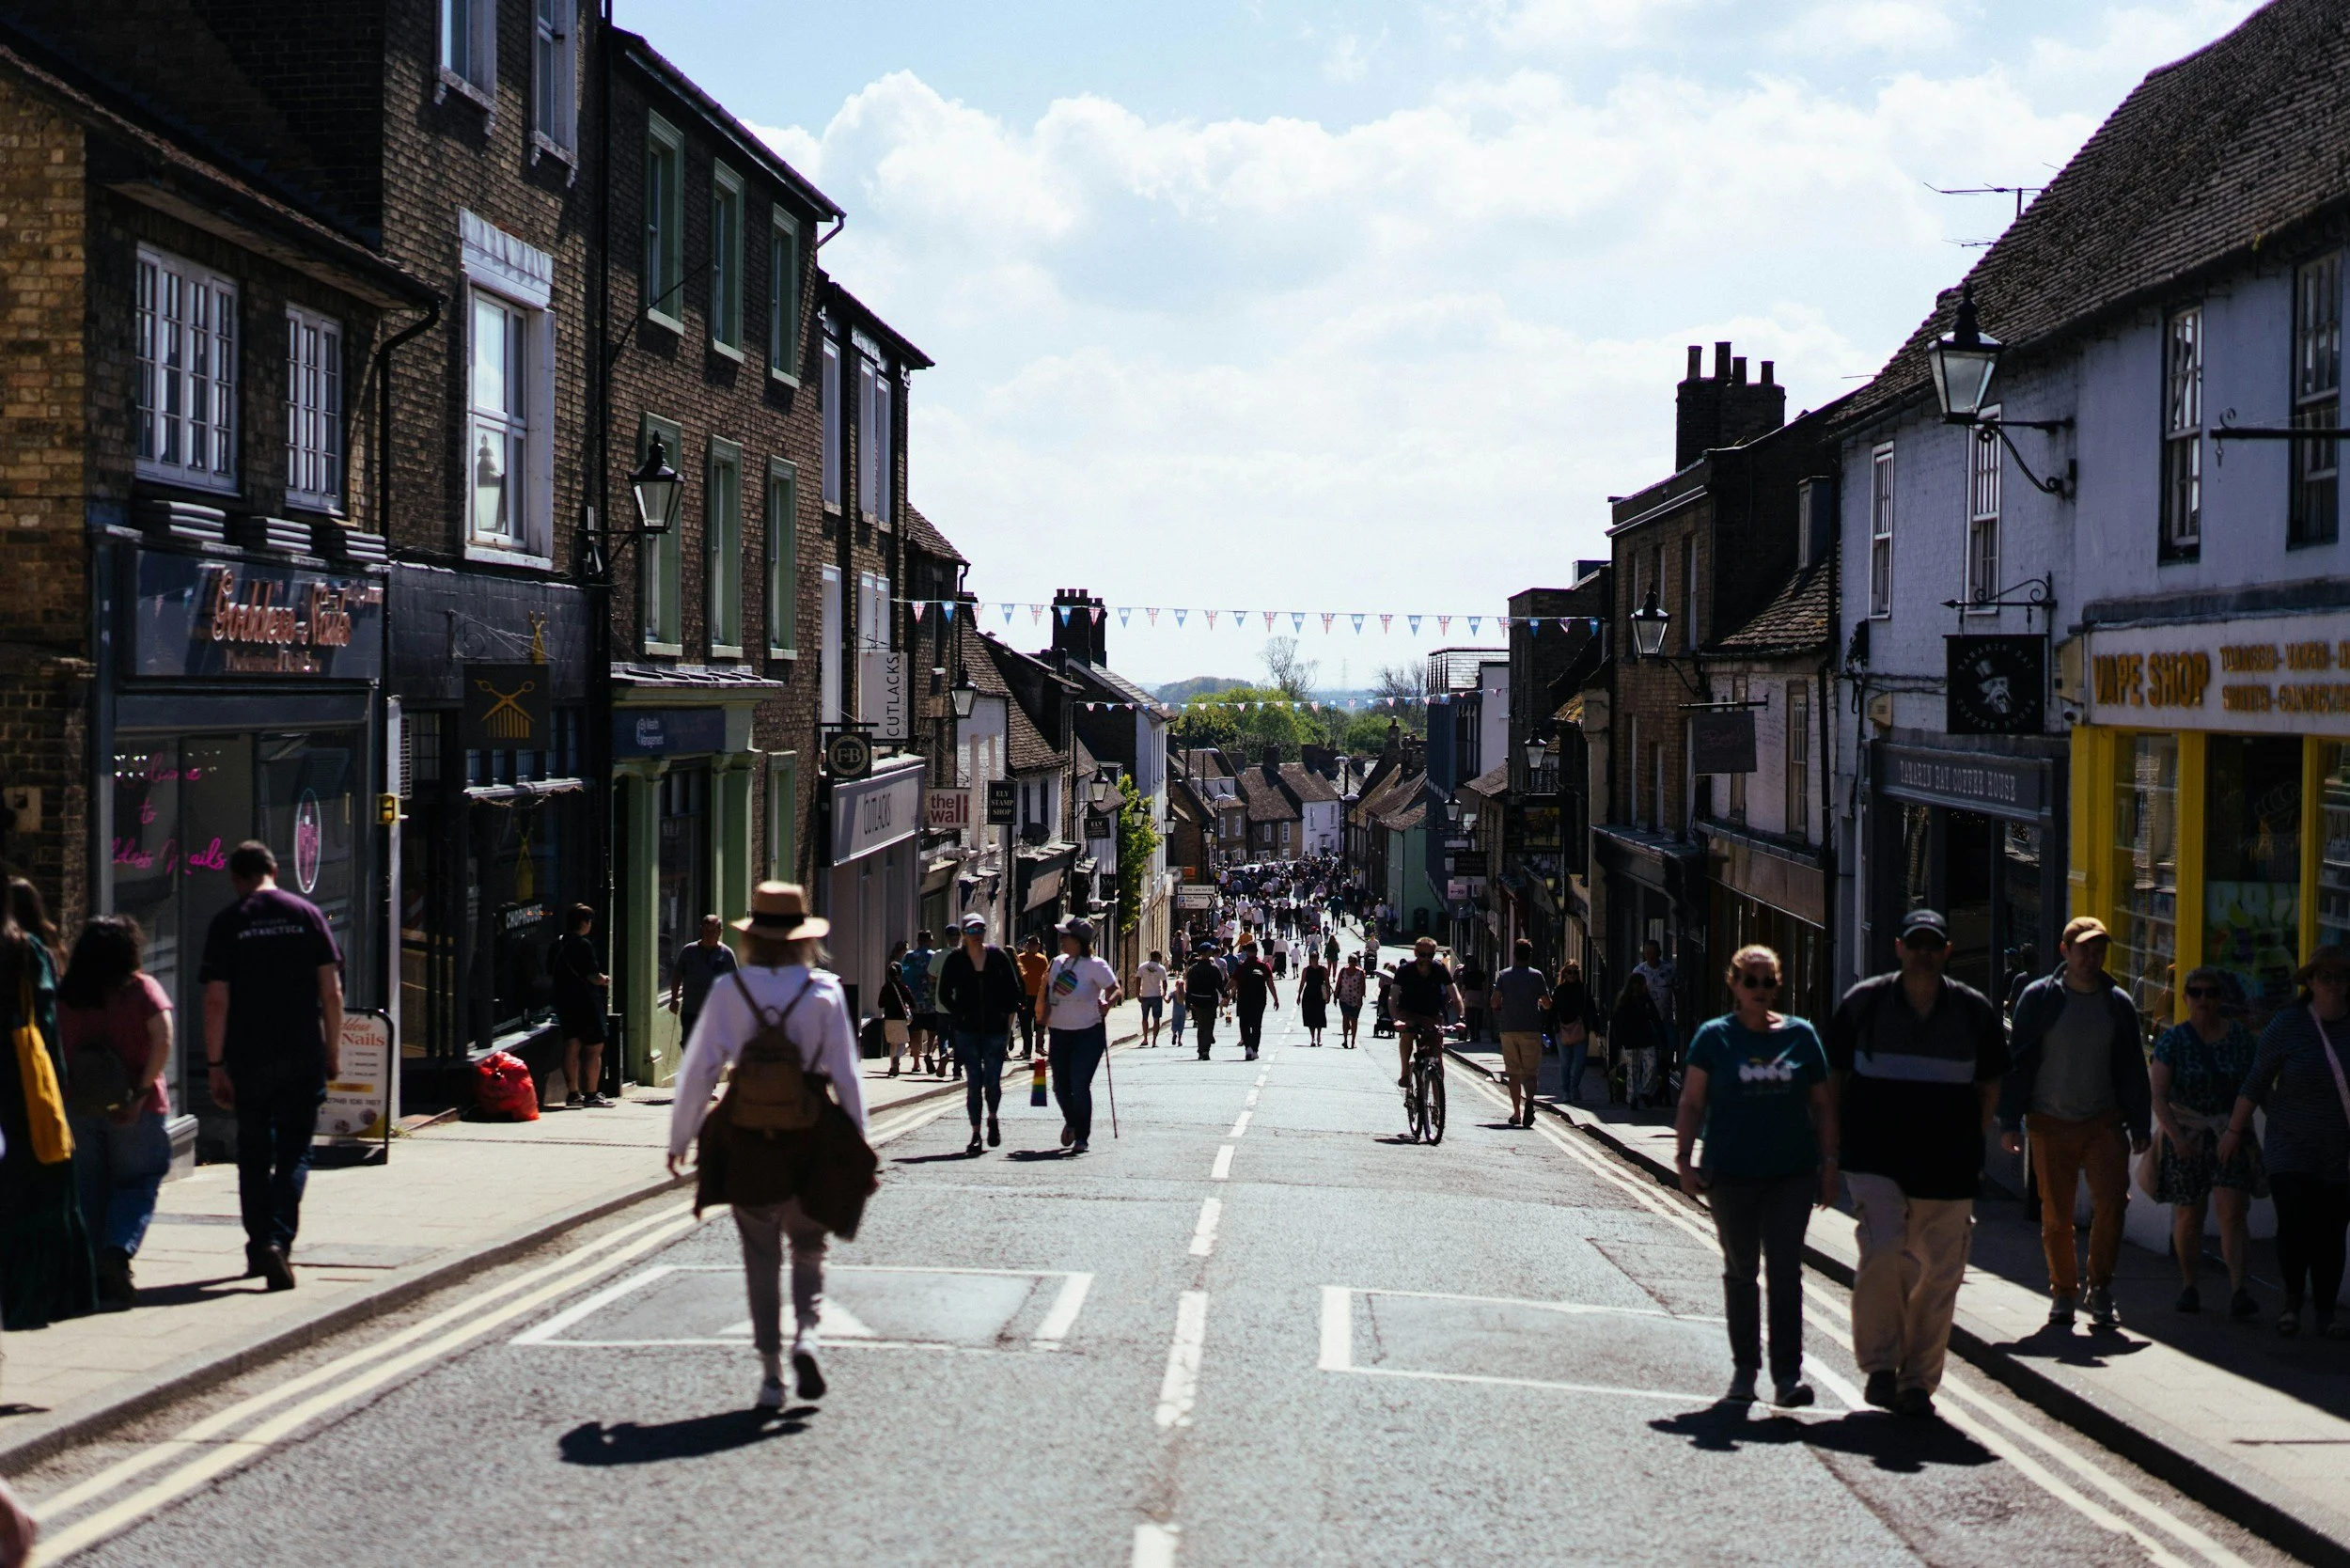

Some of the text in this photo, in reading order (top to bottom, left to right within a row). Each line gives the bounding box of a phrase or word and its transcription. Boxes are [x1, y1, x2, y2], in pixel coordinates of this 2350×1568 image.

[212, 569, 295, 644] Goddess
[1956, 643, 2008, 671] TAMARIN
[2092, 651, 2209, 707] VAPE SHOP
[886, 656, 900, 737] CUTLACKS
[1956, 698, 2036, 729] COFFEE HOUSE
[931, 793, 955, 808] the
[1952, 767, 1983, 795] COFFEE
[1987, 770, 2015, 802] HOUSE
[863, 792, 891, 835] CUTLACKS
[930, 793, 968, 823] wall
[342, 1033, 385, 1047] Nails
